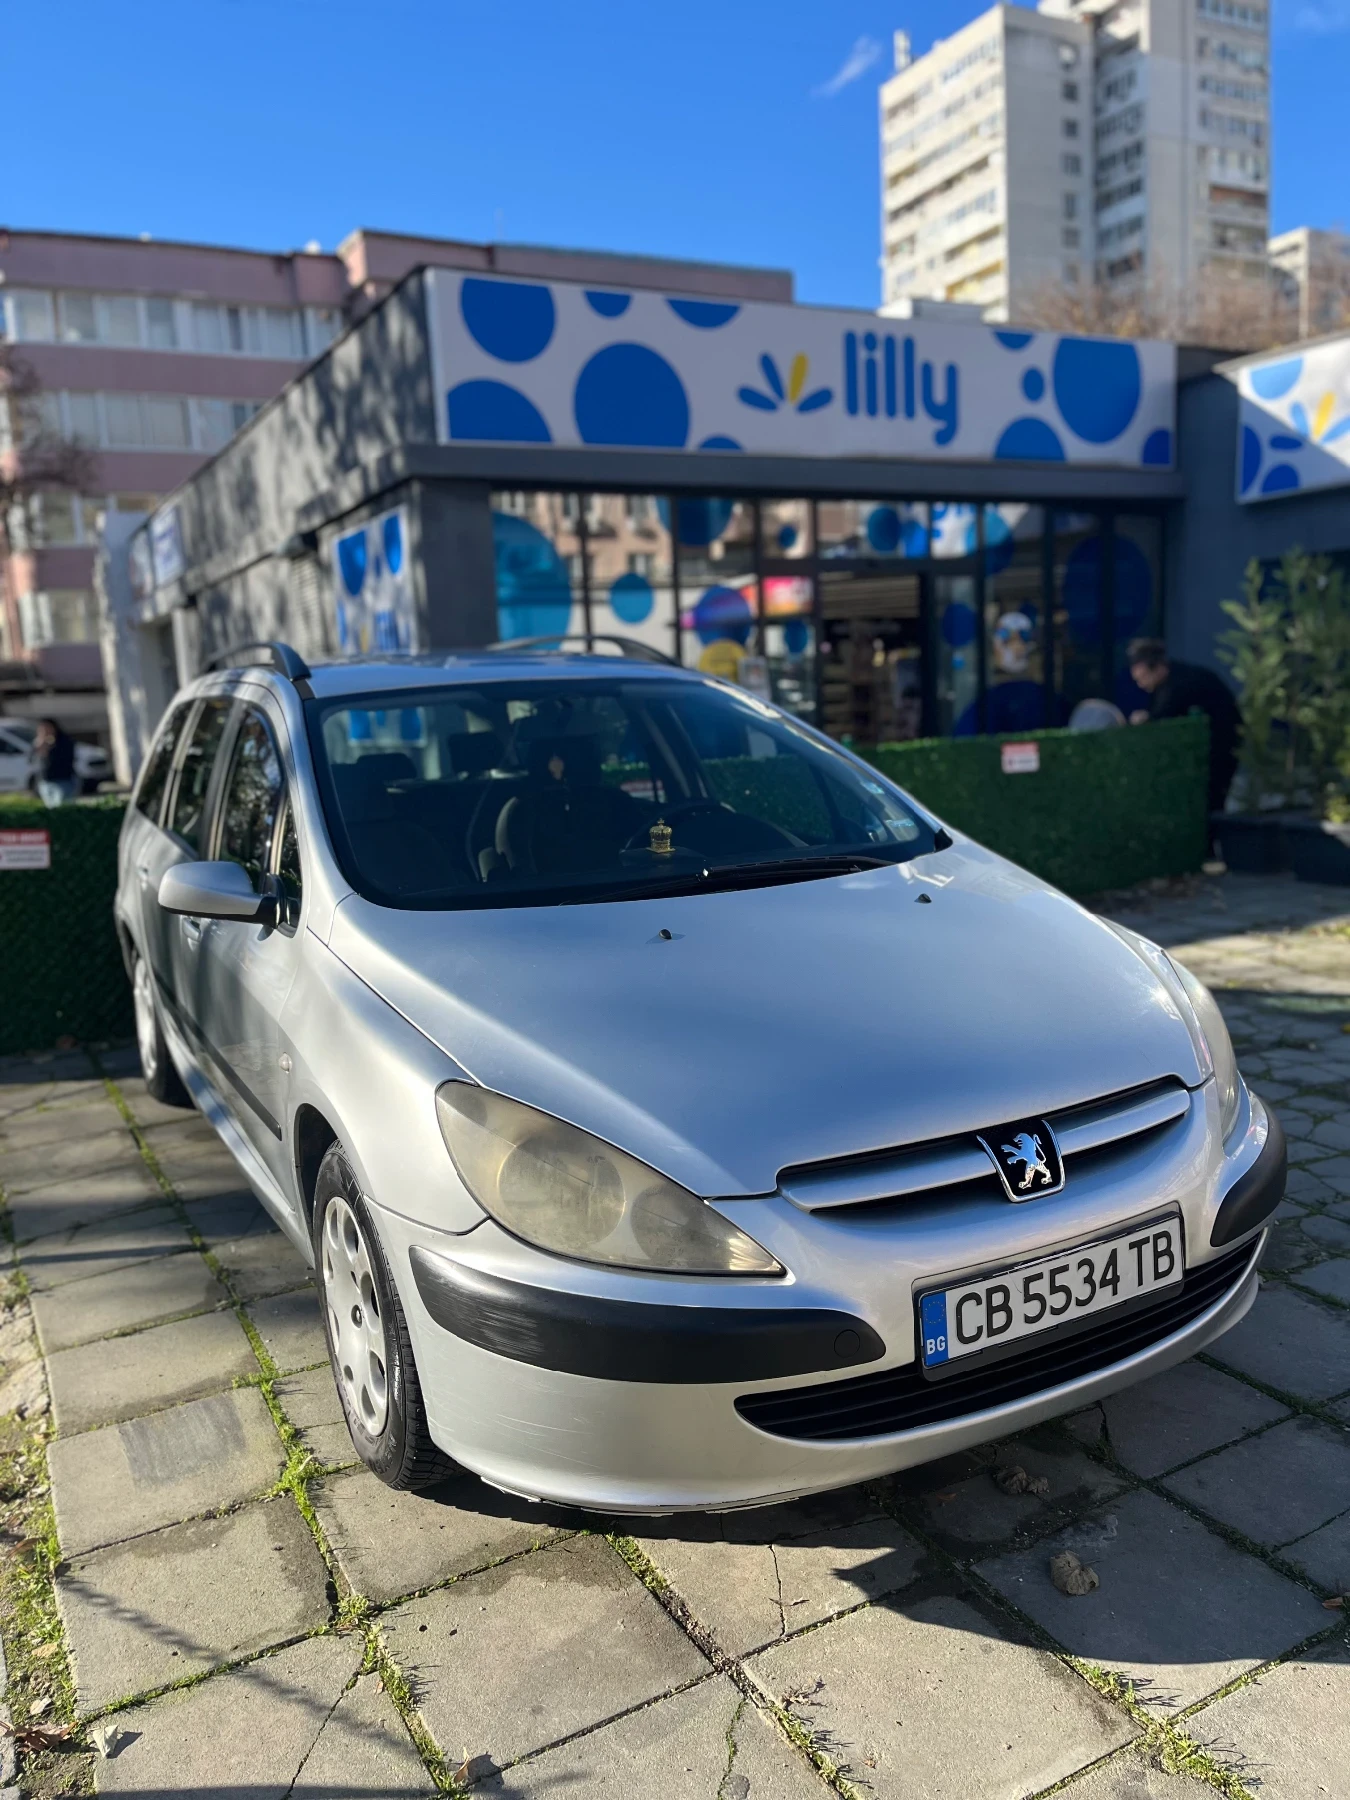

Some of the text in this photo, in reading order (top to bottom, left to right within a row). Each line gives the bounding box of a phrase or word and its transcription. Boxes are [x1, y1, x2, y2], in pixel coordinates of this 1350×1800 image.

[844, 330, 958, 446] lilly
[926, 1335, 946, 1355] BG
[955, 1230, 1176, 1345] CB 5534 TB
